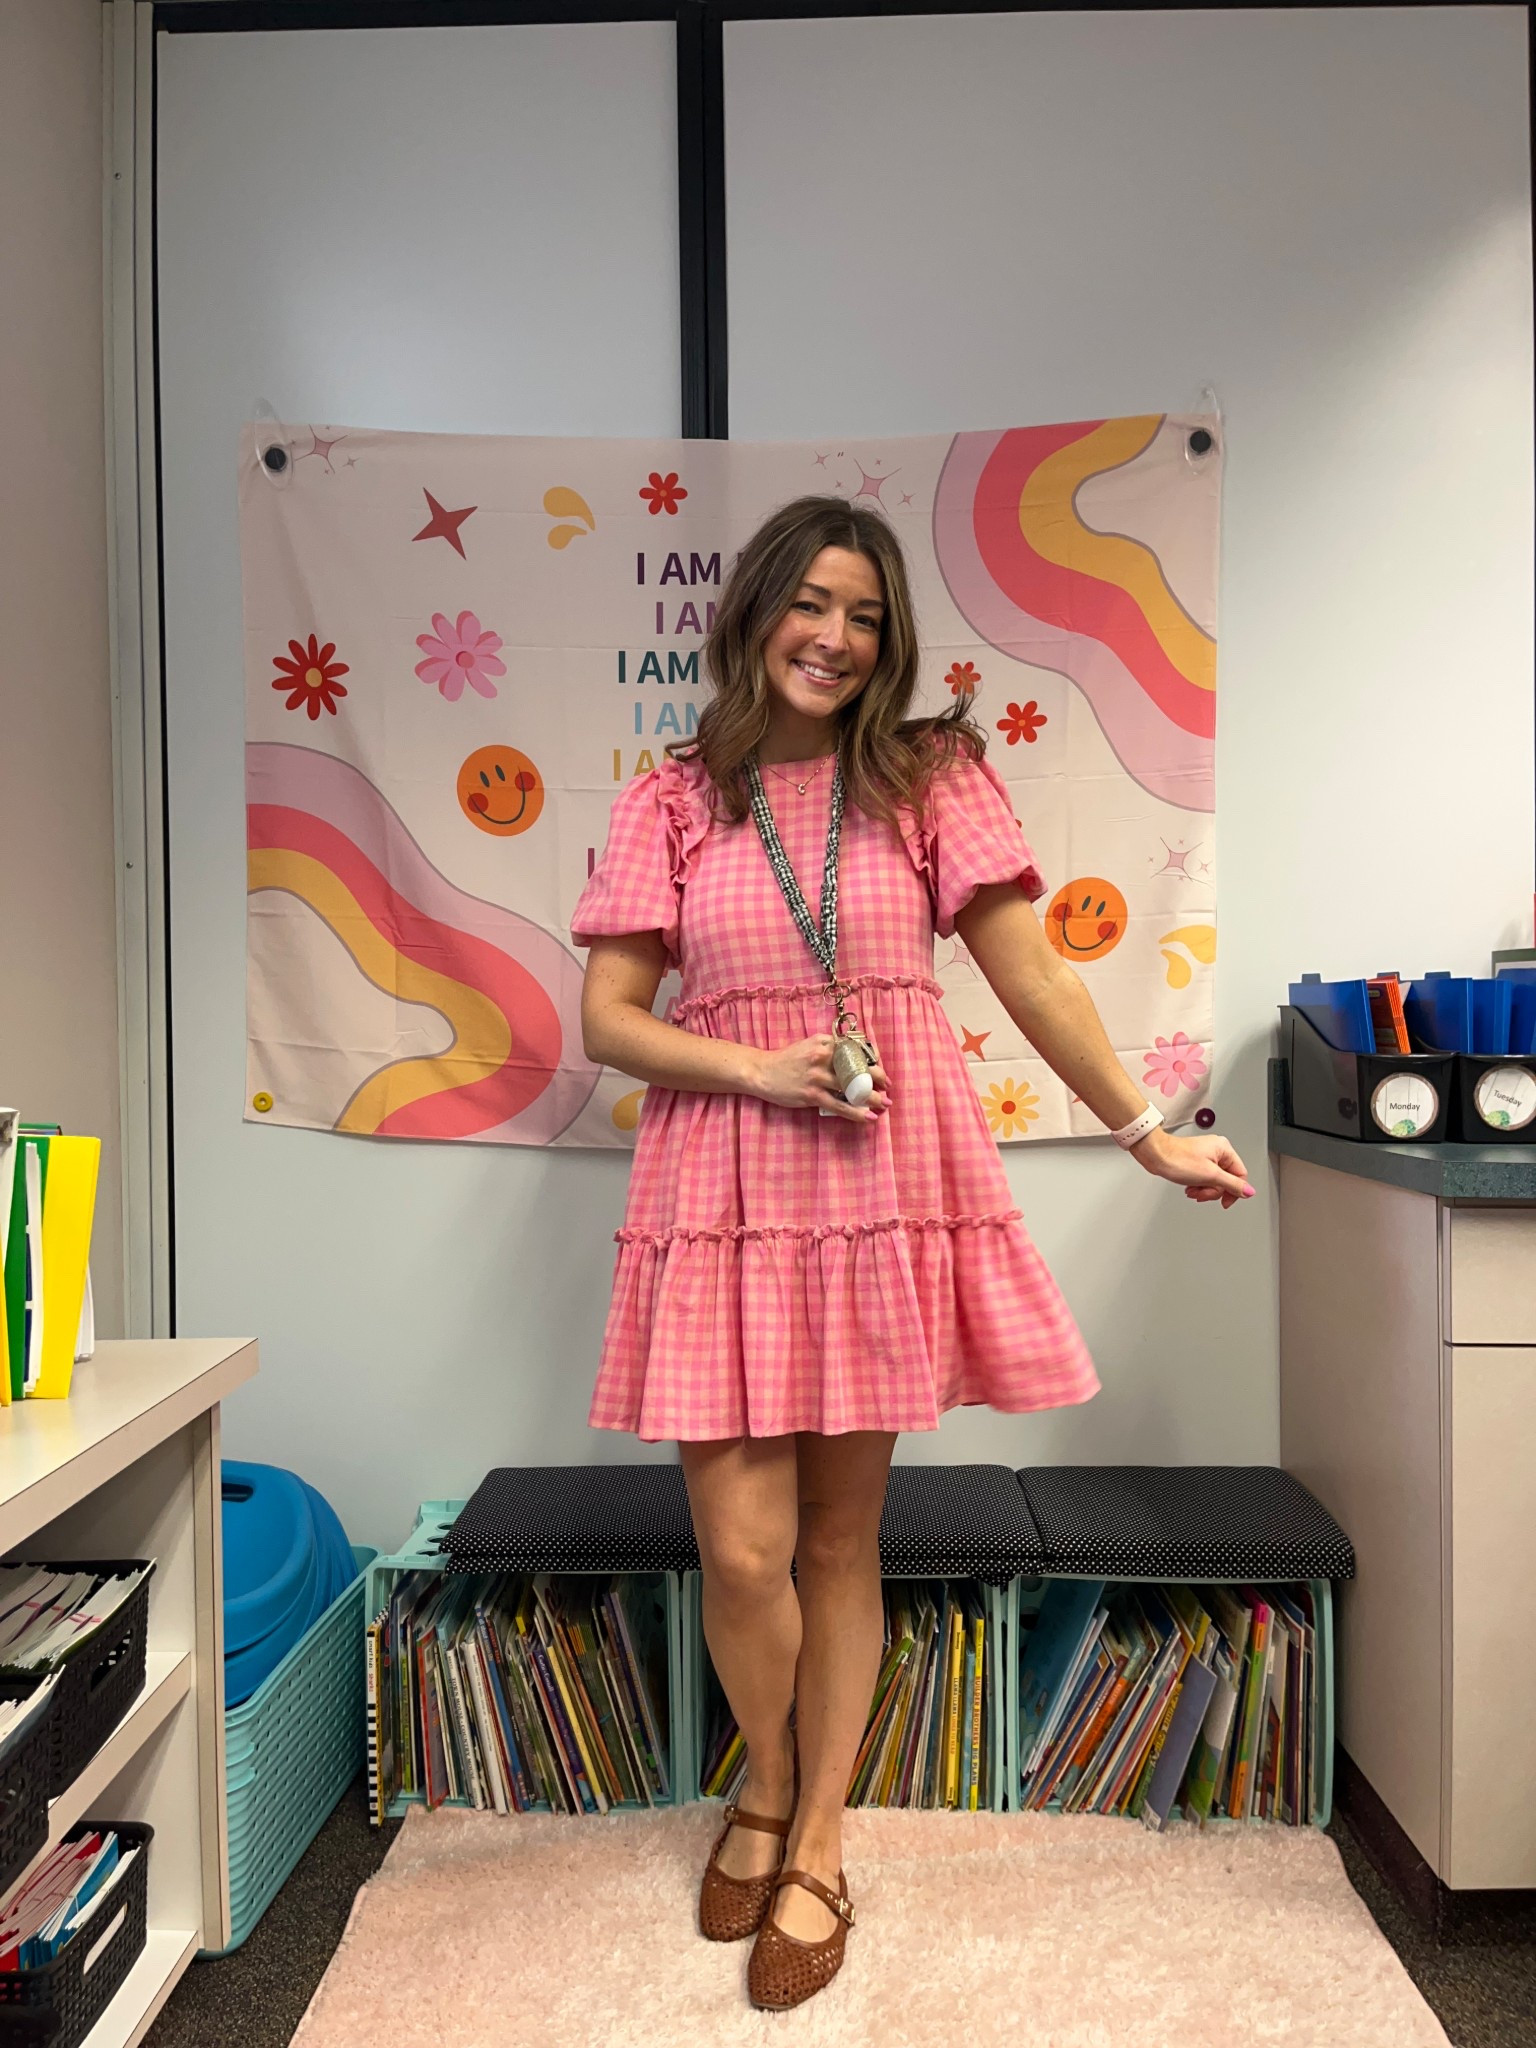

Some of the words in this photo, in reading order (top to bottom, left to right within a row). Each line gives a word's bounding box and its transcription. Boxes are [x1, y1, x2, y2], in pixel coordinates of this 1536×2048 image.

[637, 552, 645, 585] I
[659, 552, 721, 585] AM
[656, 601, 664, 634] I
[618, 651, 626, 683] I
[637, 651, 699, 684] AM
[634, 702, 642, 734] I
[613, 749, 621, 781] I
[587, 847, 595, 879] I
[1389, 1101, 1421, 1112] Monday
[1493, 1089, 1523, 1108] Tuesday
[461, 1724, 470, 1757] COUNTRY
[467, 1758, 475, 1780] MOUSE
